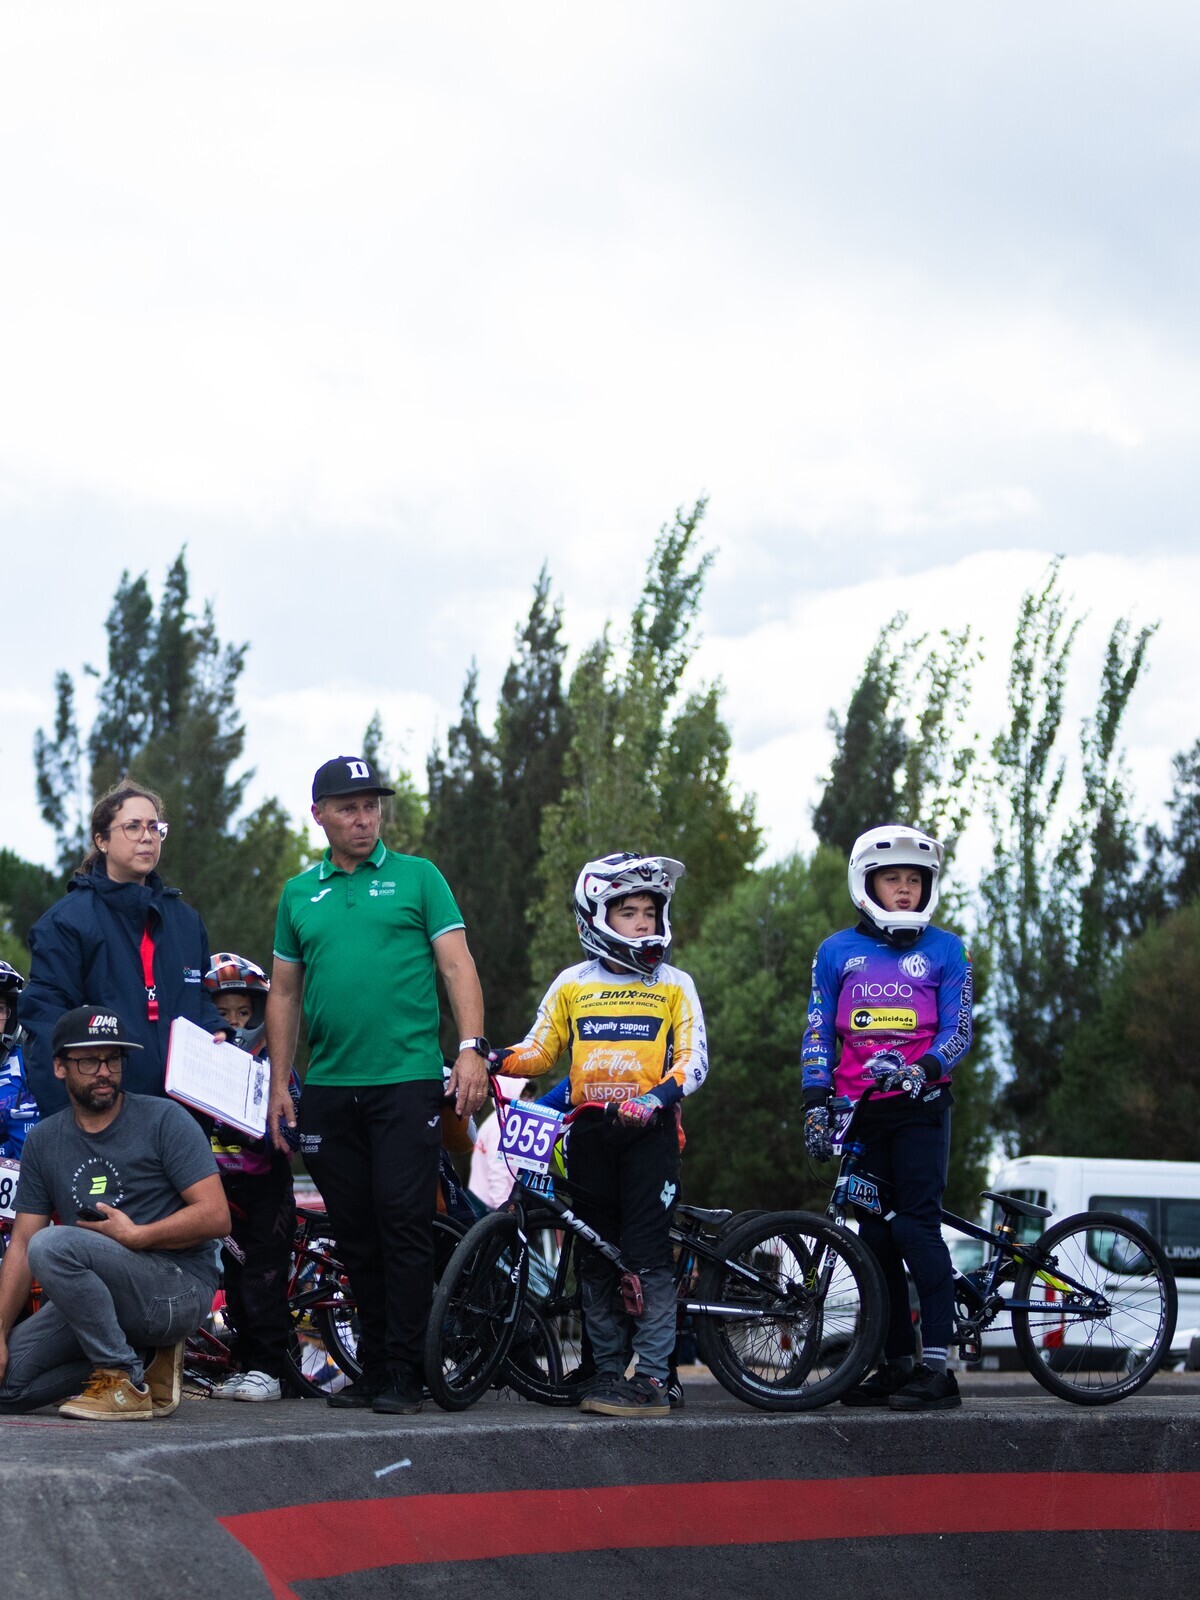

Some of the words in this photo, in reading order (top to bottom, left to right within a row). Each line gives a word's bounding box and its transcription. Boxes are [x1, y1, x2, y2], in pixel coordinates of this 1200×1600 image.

[851, 981, 913, 999] niodo
[619, 1021, 650, 1035] support
[582, 1057, 597, 1072] de
[516, 1100, 559, 1117] SHIMANO
[502, 1114, 556, 1157] 955
[560, 1208, 622, 1262] MEYB
